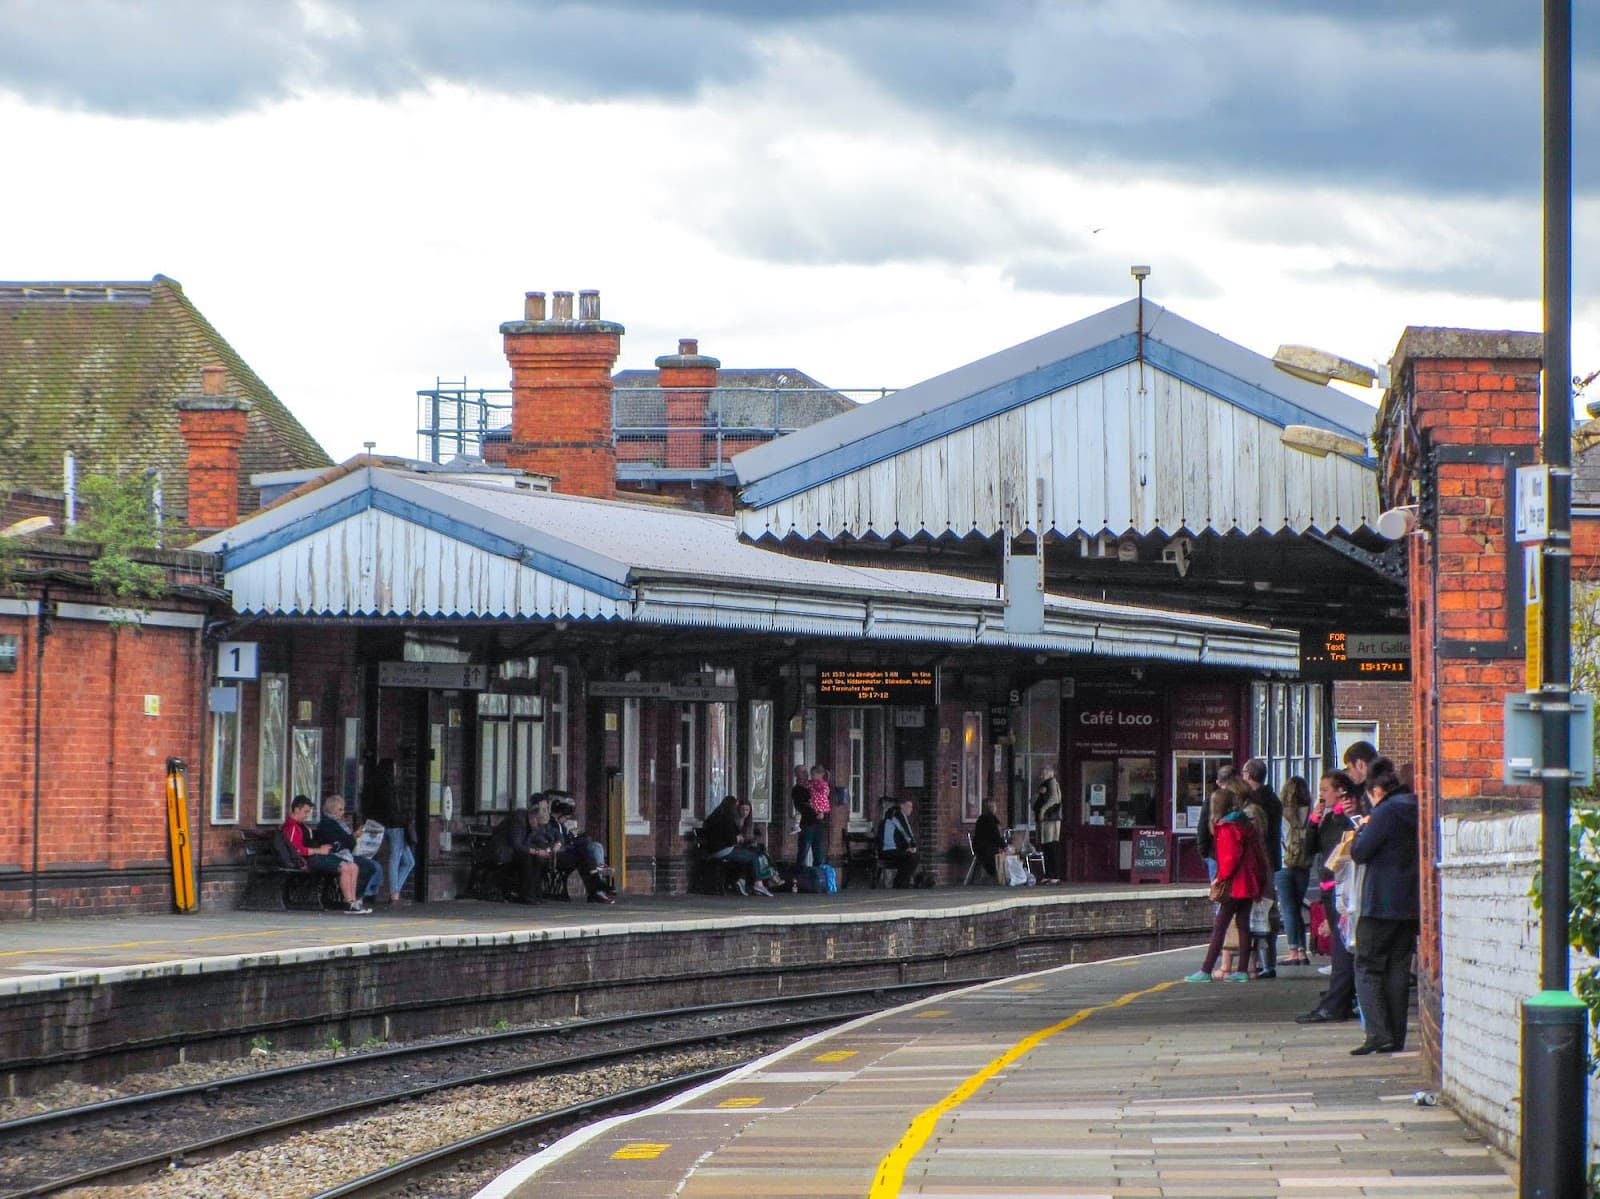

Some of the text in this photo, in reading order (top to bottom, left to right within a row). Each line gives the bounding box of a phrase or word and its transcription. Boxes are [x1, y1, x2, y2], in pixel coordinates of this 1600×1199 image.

[1329, 633, 1345, 641] FOR
[1326, 643, 1345, 651] Text
[1358, 641, 1376, 654] Art
[230, 647, 240, 672] 1
[1360, 663, 1404, 671] 15:17:11
[1080, 710, 1153, 725] Café Loco
[1217, 719, 1230, 728] on
[1204, 731, 1229, 741] LINES
